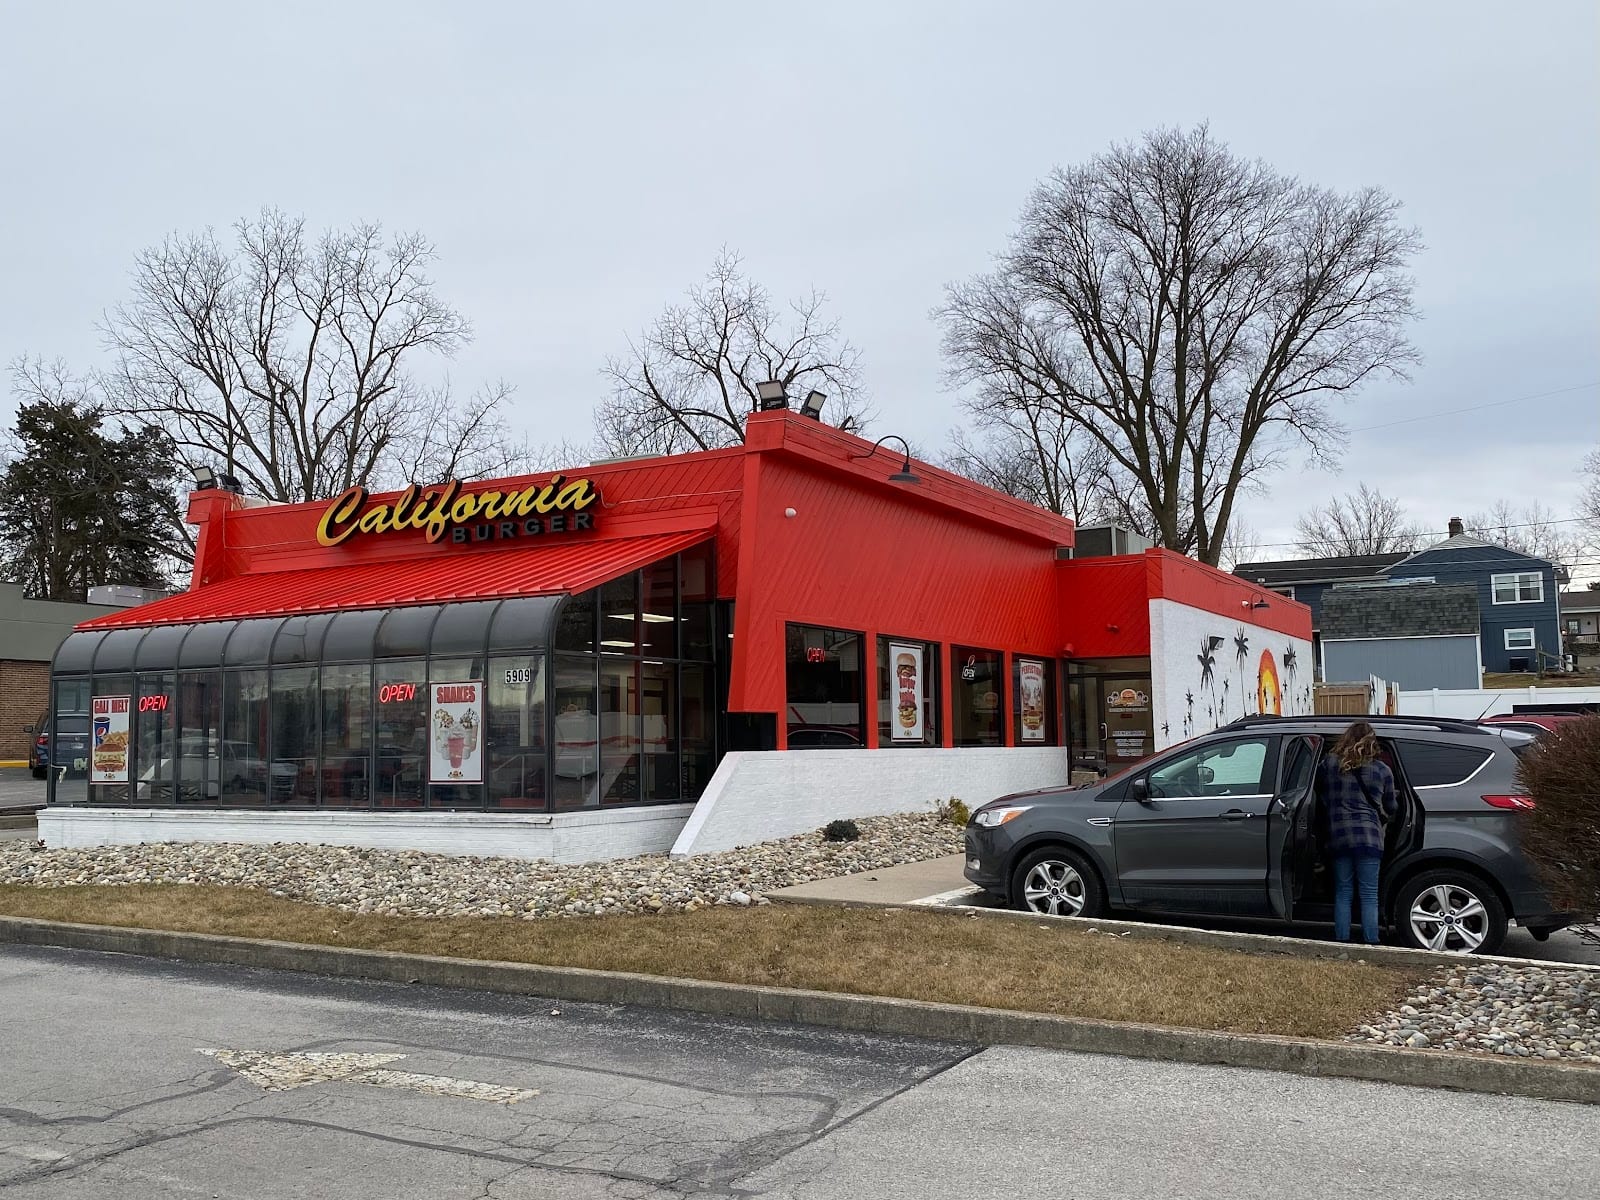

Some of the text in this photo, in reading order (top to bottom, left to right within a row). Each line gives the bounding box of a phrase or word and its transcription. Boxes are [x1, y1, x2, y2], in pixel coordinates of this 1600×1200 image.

[316, 474, 597, 547] California
[452, 512, 593, 544] BURGER
[505, 669, 530, 683] 5909
[379, 684, 416, 703] OPEN
[436, 685, 476, 704] SHAKES
[139, 696, 168, 712] OPEN
